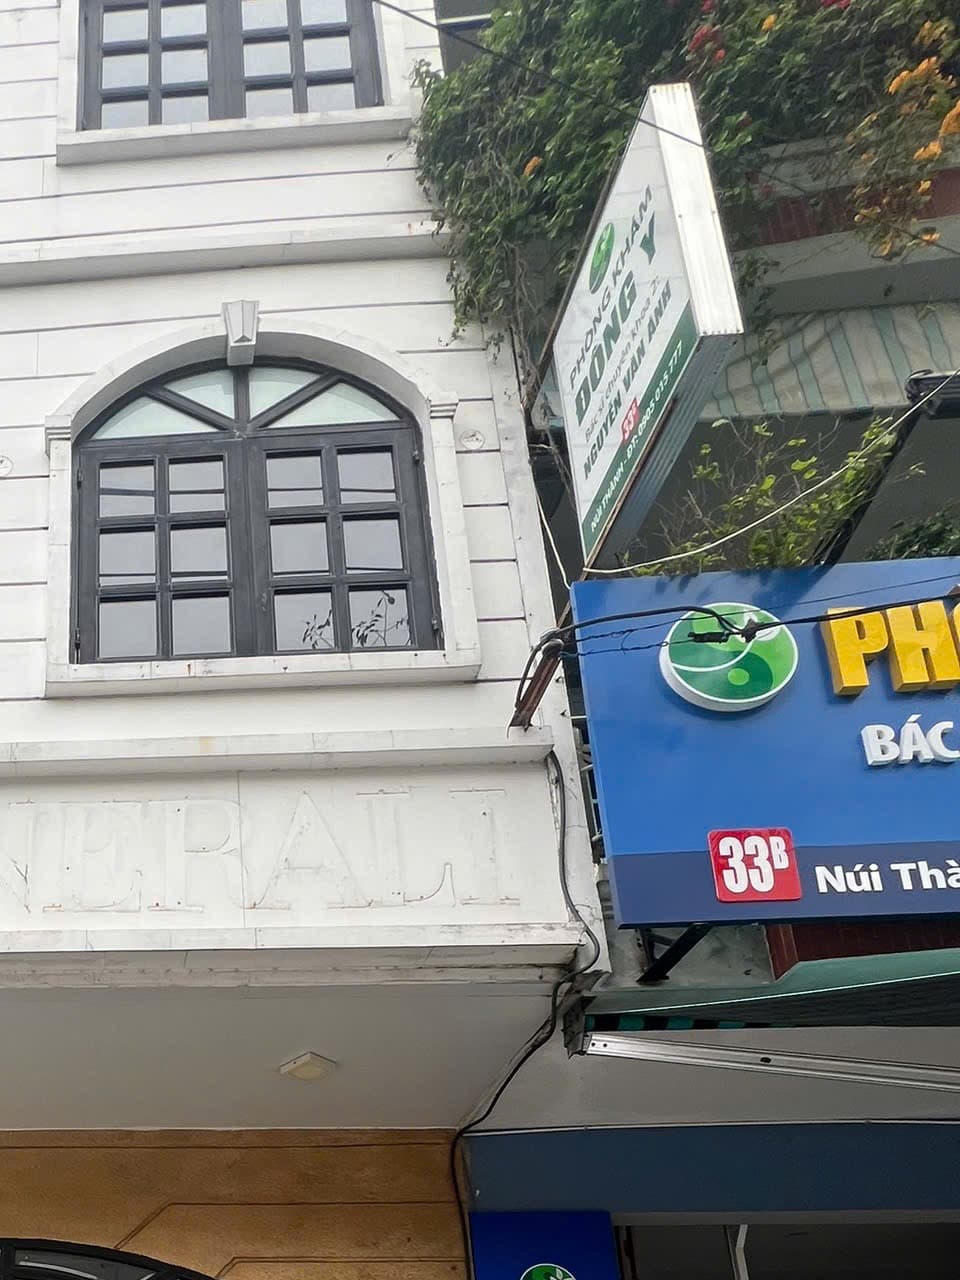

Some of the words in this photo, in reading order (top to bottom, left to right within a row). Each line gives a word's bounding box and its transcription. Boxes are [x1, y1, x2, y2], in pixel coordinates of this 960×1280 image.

[824, 600, 960, 696] PH
[861, 713, 960, 767] BÁC
[814, 862, 884, 894] Núi
